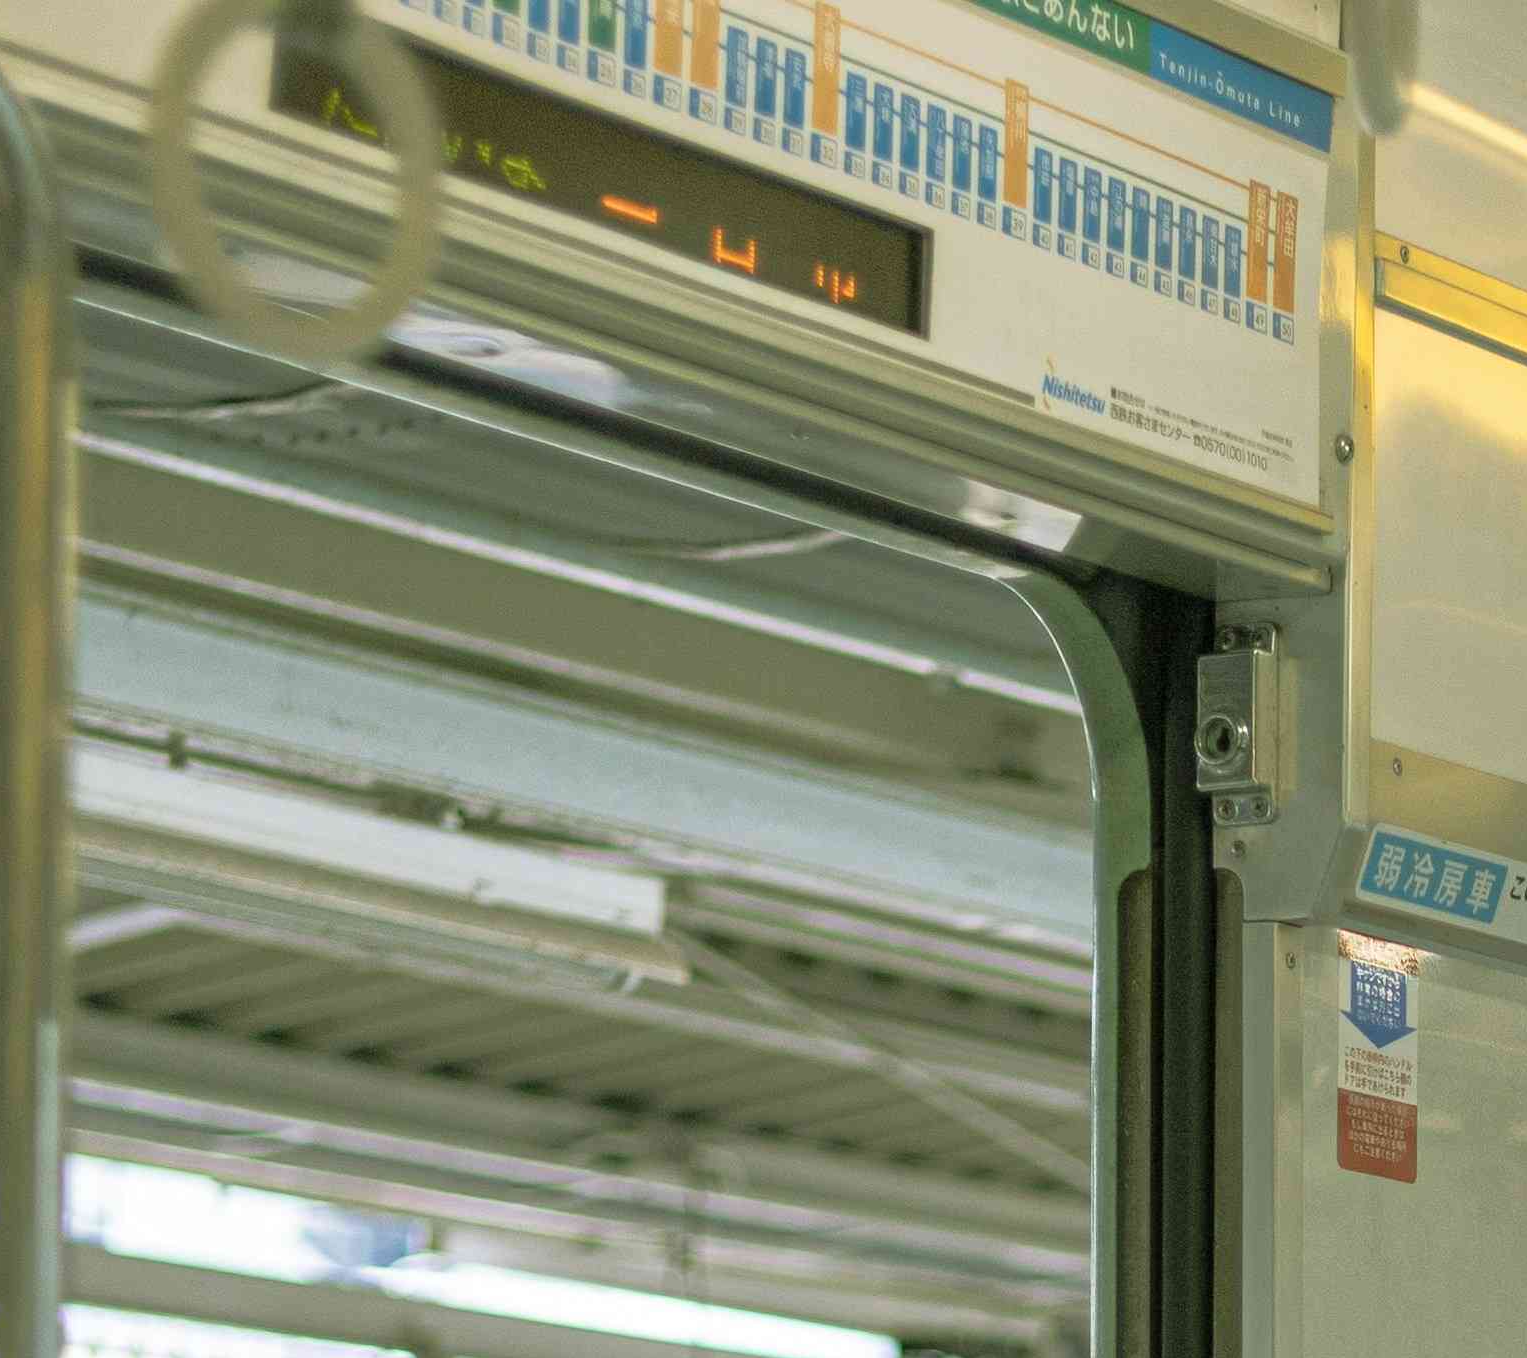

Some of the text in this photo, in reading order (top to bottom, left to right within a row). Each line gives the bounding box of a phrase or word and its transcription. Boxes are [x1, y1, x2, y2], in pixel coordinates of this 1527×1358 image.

[1269, 98, 1302, 128] Line
[1282, 199, 1296, 259] 大牟田
[1042, 374, 1106, 416] Nishitetsu
[1374, 843, 1497, 915] 弱冷房車
